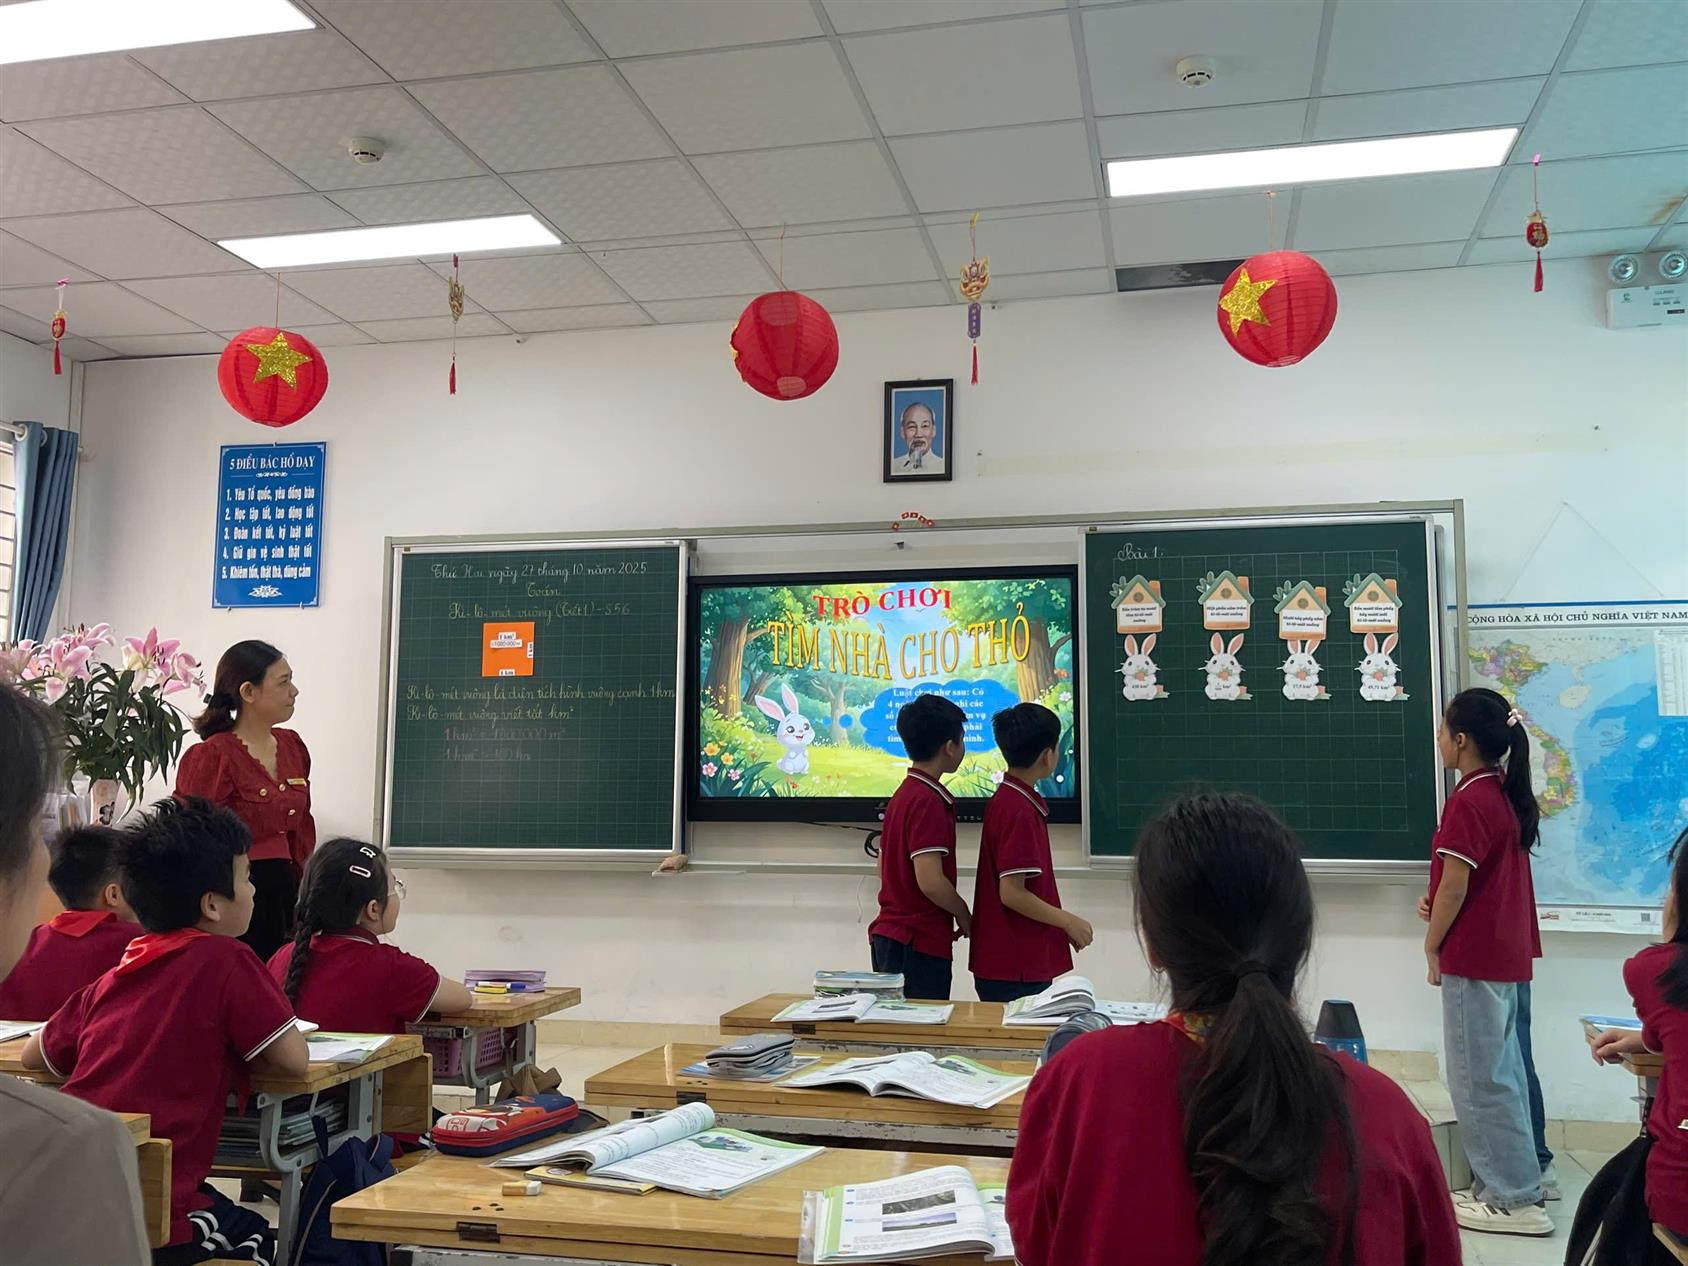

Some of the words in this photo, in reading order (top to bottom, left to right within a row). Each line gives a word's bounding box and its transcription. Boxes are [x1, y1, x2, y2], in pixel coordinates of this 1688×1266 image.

[229, 458, 235, 470] 5
[260, 455, 278, 469] BÁC
[296, 456, 316, 470] DẠY
[226, 488, 232, 501] 1.
[225, 508, 231, 520] 2.
[224, 527, 230, 540] 3.
[1118, 542, 1148, 562] Bài
[222, 566, 228, 579] 5.
[488, 566, 517, 584] ngày
[521, 564, 534, 577] 27
[538, 562, 569, 583] tháng
[572, 563, 584, 576] 10
[588, 563, 616, 575] năm
[618, 562, 648, 574] 2025
[814, 592, 870, 618] TRÒ
[879, 588, 951, 610] CHƠI
[1499, 613, 1521, 623] HÒA
[1544, 612, 1563, 623] HỘI
[1566, 610, 1589, 622] CHỦ
[1632, 611, 1658, 622] VIỆT
[1662, 610, 1688, 619] NAM
[768, 612, 820, 670] TÌM
[829, 624, 892, 680] NHÀ
[900, 628, 960, 679] CHO
[966, 602, 1030, 668] THỎ
[894, 688, 912, 698] Luật
[972, 688, 984, 696] Có
[885, 711, 894, 719] số
